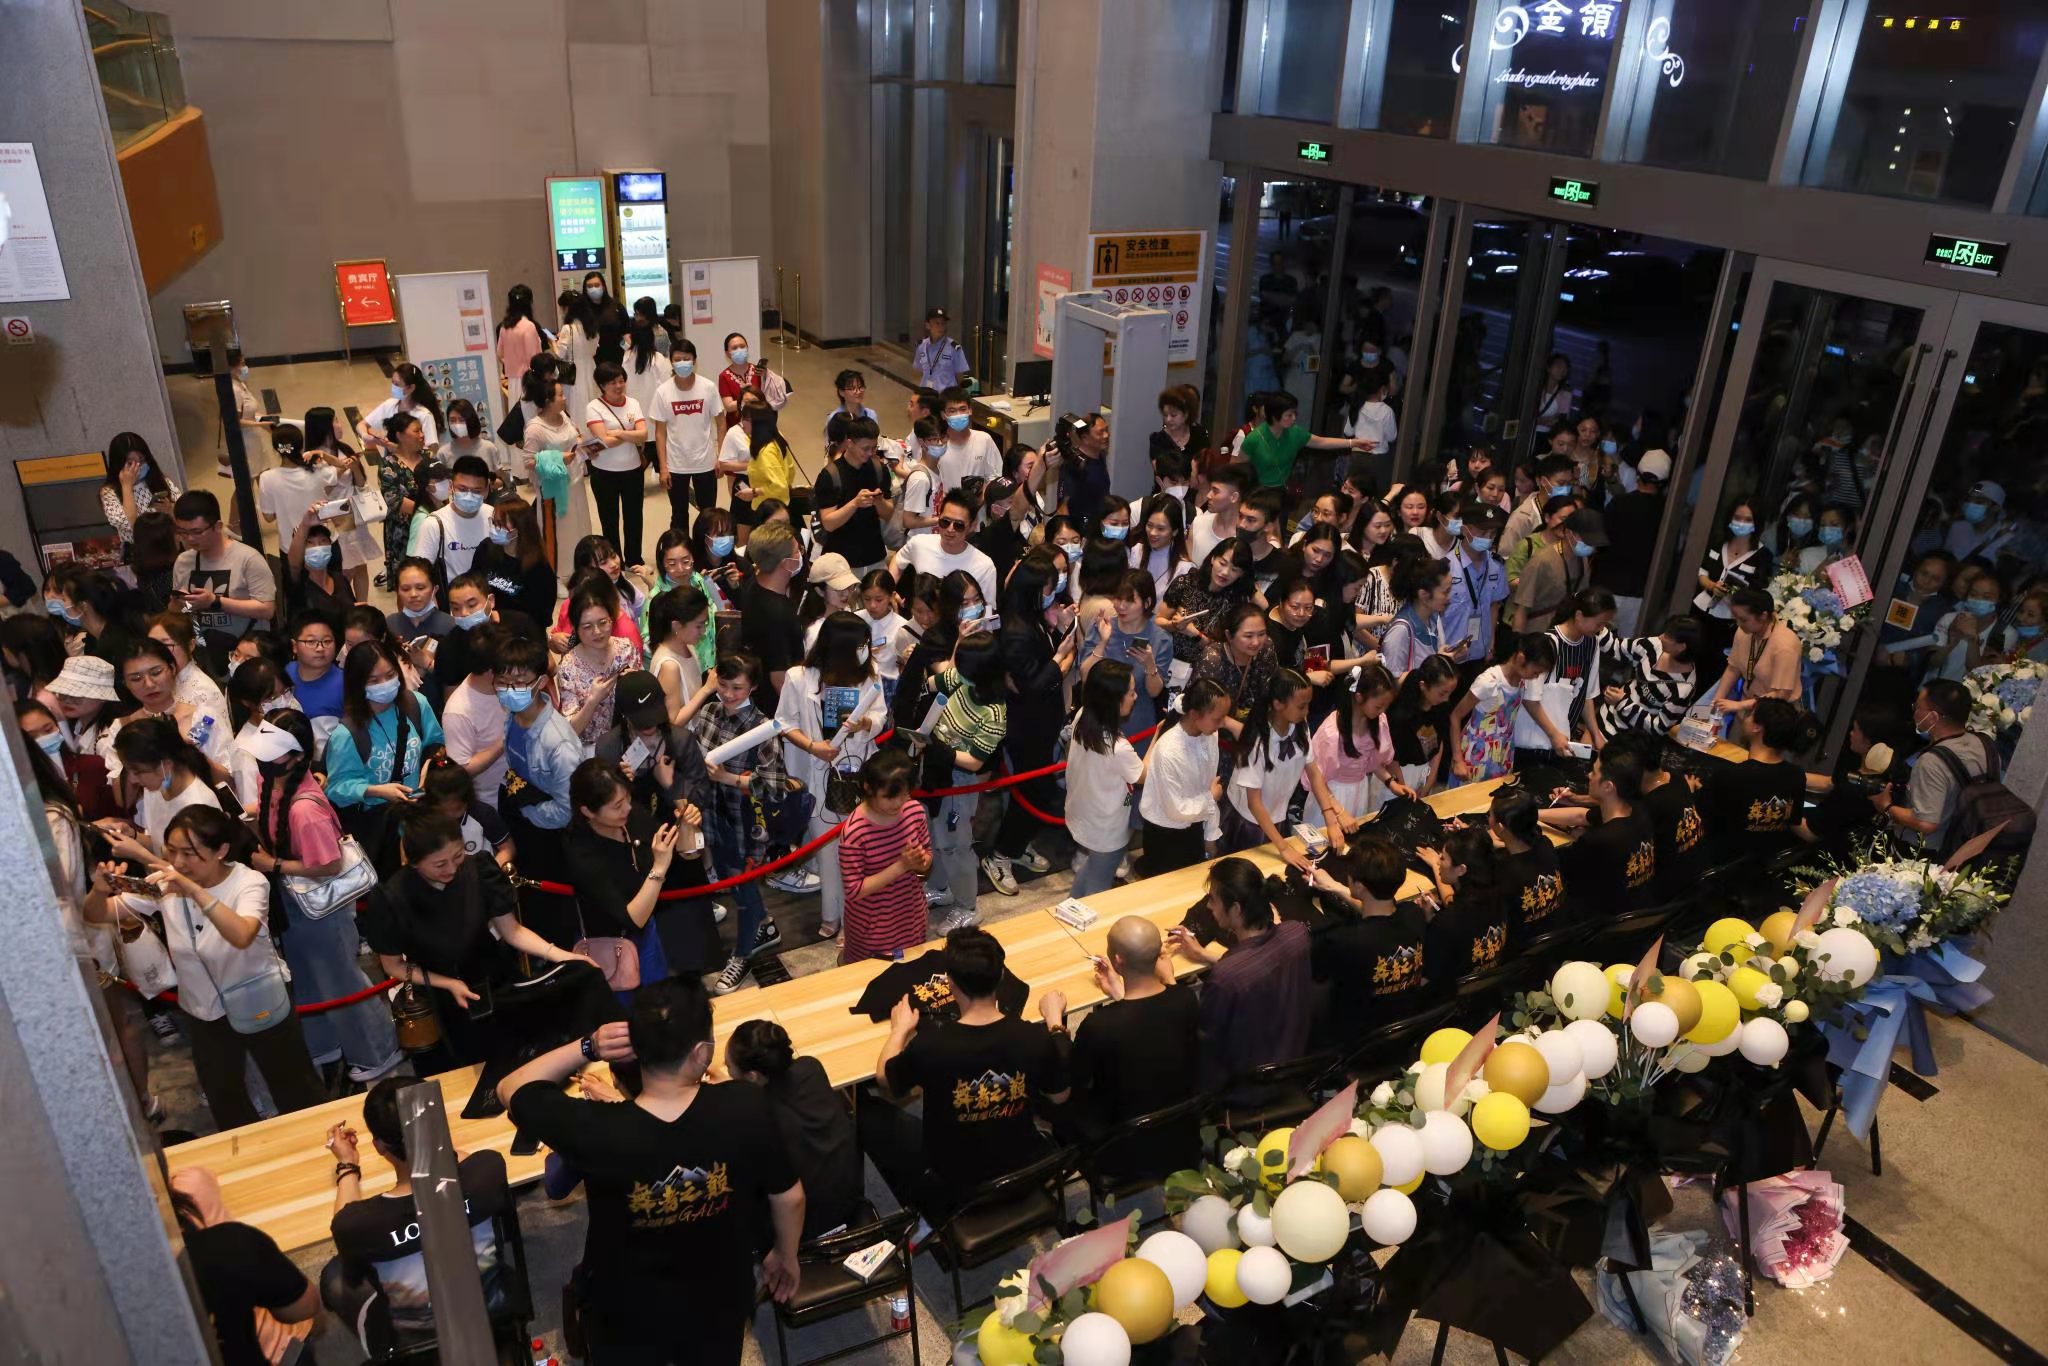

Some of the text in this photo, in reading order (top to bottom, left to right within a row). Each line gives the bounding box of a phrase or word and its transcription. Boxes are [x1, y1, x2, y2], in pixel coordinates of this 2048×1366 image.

[1975, 254, 1994, 265] EXIT
[217, 615, 228, 625] 03
[678, 1196, 729, 1222] GALA
